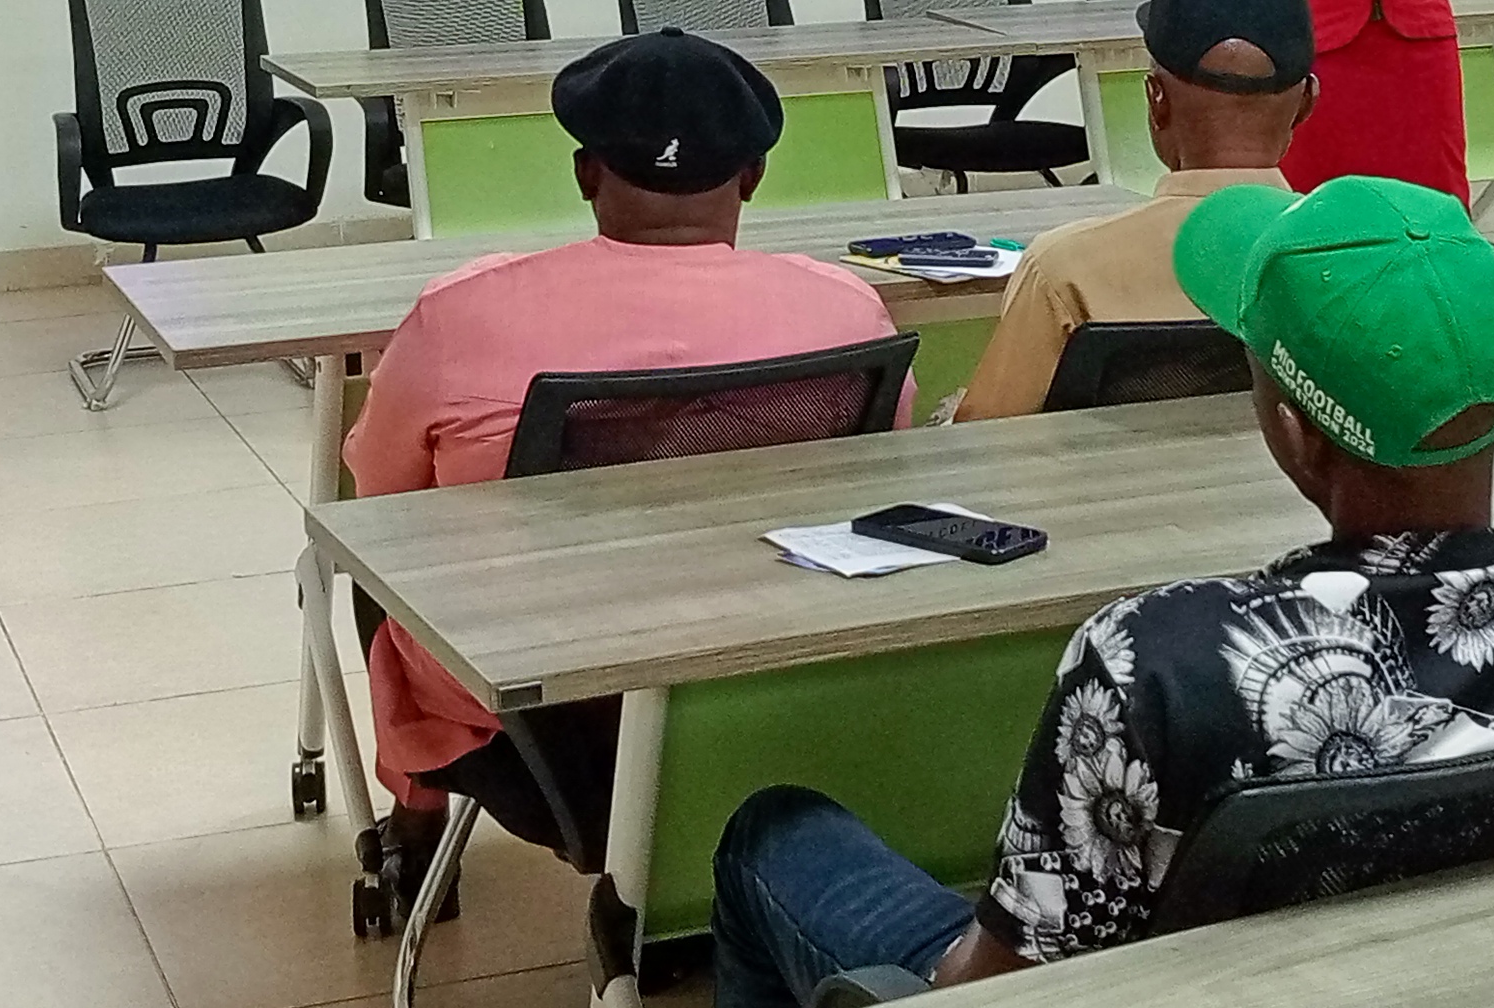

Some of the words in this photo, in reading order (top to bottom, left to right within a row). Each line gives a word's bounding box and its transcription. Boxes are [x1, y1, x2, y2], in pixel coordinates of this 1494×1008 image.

[1271, 357, 1341, 434] COMPETITION
[1342, 430, 1375, 458] 2024
[1296, 369, 1375, 445] FOOTBALL
